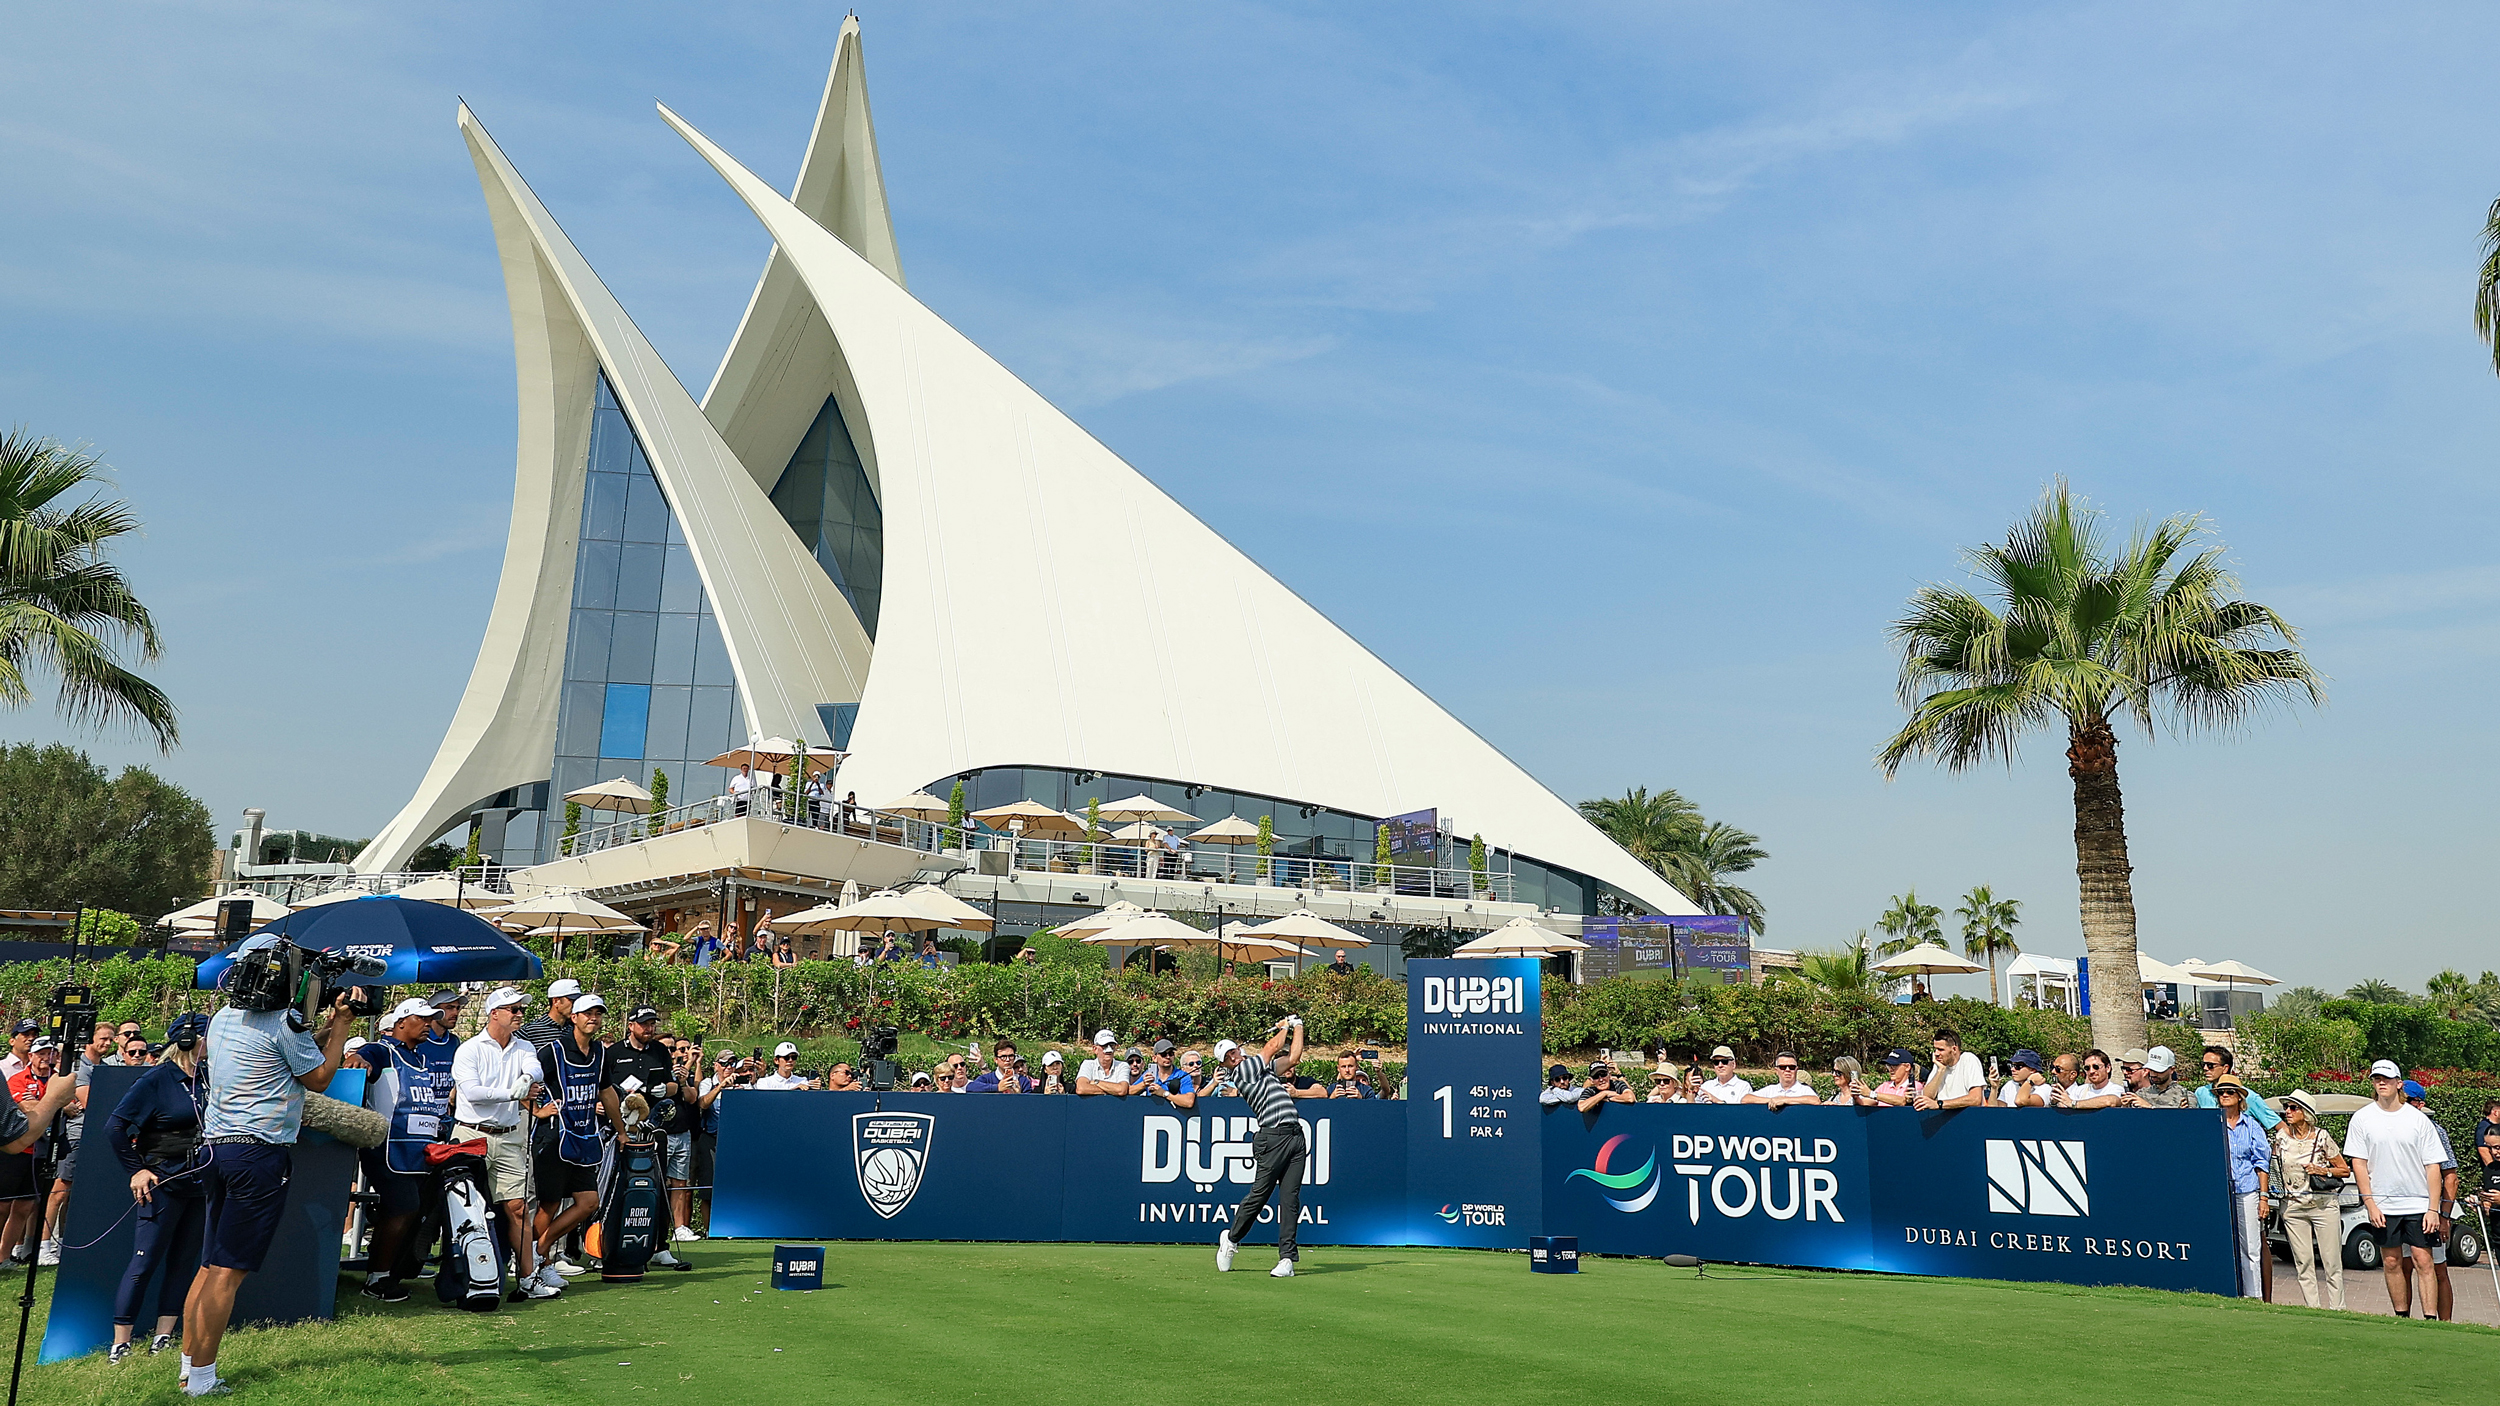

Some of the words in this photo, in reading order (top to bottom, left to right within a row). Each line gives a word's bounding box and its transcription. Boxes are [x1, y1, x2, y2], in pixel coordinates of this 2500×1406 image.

[345, 948, 393, 958] TOUR
[1635, 949, 1664, 963] DUBAI
[1710, 954, 1737, 964] TOUR
[1424, 976, 1523, 1019] DUBAI
[1424, 1023, 1524, 1035] INVITATIONAL
[1469, 1086, 1489, 1098] 451
[1491, 1086, 1513, 1101] yds
[1433, 1085, 1452, 1138] 1
[1469, 1106, 1491, 1118] 412
[1493, 1109, 1507, 1119] m
[863, 1128, 923, 1139] DUBAI
[1470, 1126, 1493, 1138] PAR
[1494, 1126, 1503, 1138] 4
[1672, 1134, 1714, 1159] DP
[1717, 1135, 1838, 1164] WORLD
[1673, 1164, 1846, 1226] TOUR
[629, 1207, 649, 1217] RORY
[1462, 1203, 1474, 1211] DP
[1474, 1204, 1505, 1212] WORLD
[1462, 1211, 1506, 1227] TOUR
[1905, 1227, 1978, 1247] DUBAI
[1990, 1232, 2073, 1254] CREEK
[2084, 1236, 2192, 1261] RESORT
[1562, 1253, 1577, 1261] TOUR
[789, 1260, 817, 1273] DUBAI
